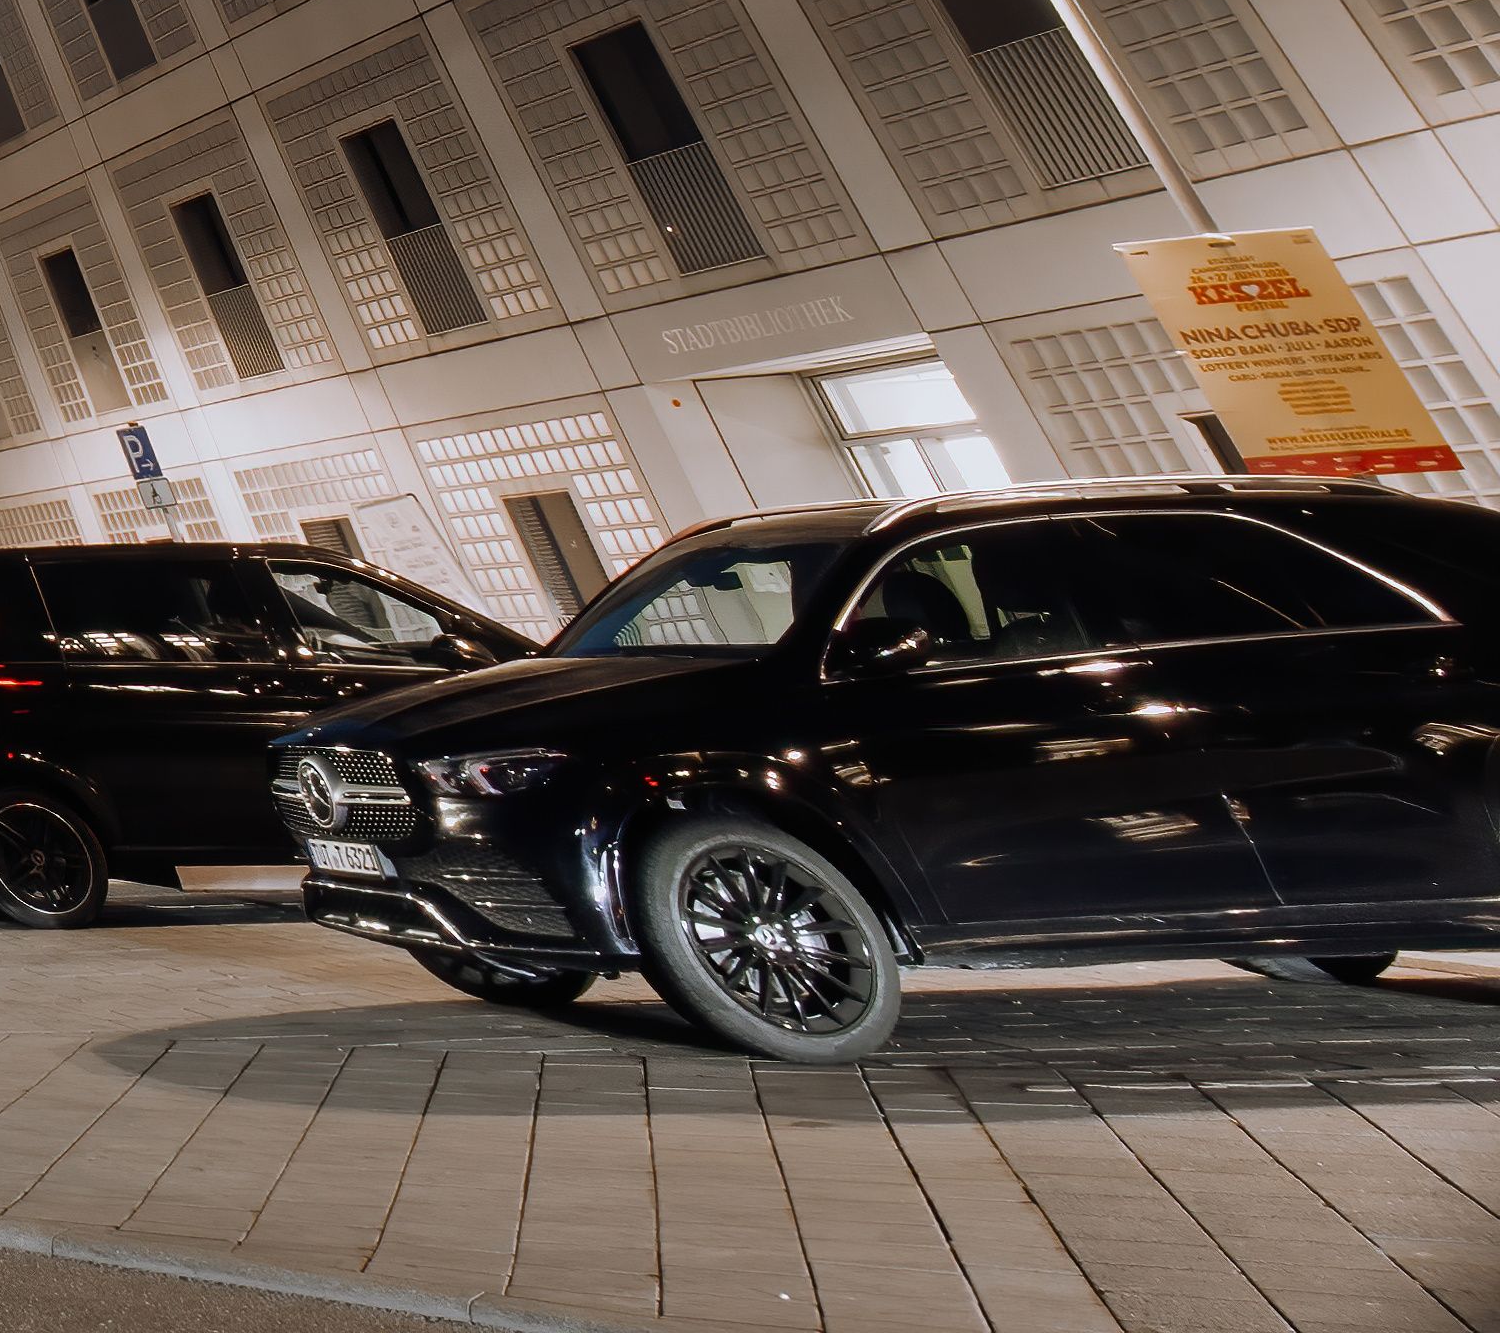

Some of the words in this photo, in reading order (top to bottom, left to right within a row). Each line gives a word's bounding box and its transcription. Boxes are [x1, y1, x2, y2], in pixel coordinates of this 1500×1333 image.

[661, 295, 855, 354] STADTBIBLIOTHEK
[1180, 326, 1242, 345] NINA
[1240, 321, 1320, 339] CHUBA
[1323, 317, 1361, 333] SDP
[1190, 345, 1236, 359] SOHO
[1240, 343, 1276, 356] BANI
[1286, 341, 1314, 352] JULI
[123, 435, 144, 473] P
[345, 846, 379, 871] 6321
